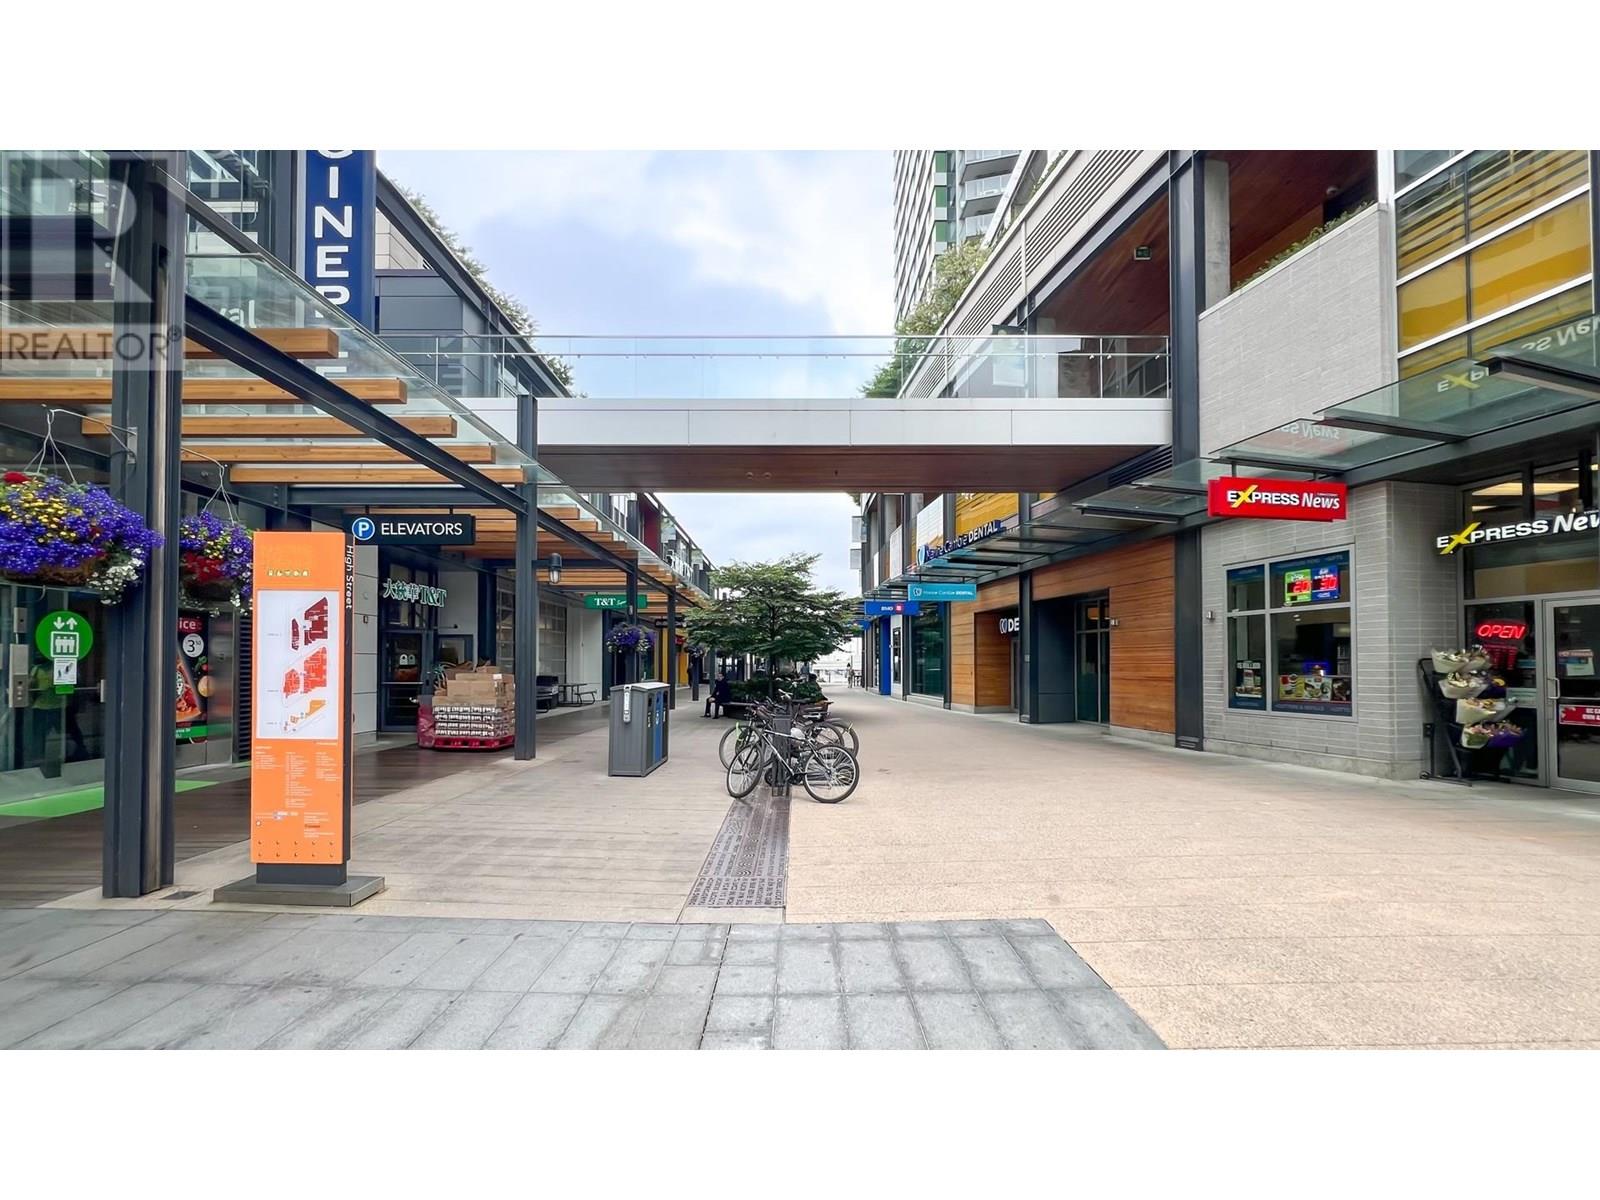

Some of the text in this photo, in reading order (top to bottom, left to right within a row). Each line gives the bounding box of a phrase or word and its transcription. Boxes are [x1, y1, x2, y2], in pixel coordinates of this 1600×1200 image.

[313, 150, 352, 413] INEP
[1227, 484, 1340, 509] EXPRESS News
[359, 522, 463, 537] P ELEVATORS
[968, 521, 998, 543] DENTAL
[1436, 520, 1549, 555] EXPRESS
[345, 545, 354, 609] High Street
[419, 584, 447, 608] T&T
[594, 598, 616, 606] T&T
[1477, 624, 1526, 639] OPEN
[187, 639, 195, 653] 3
